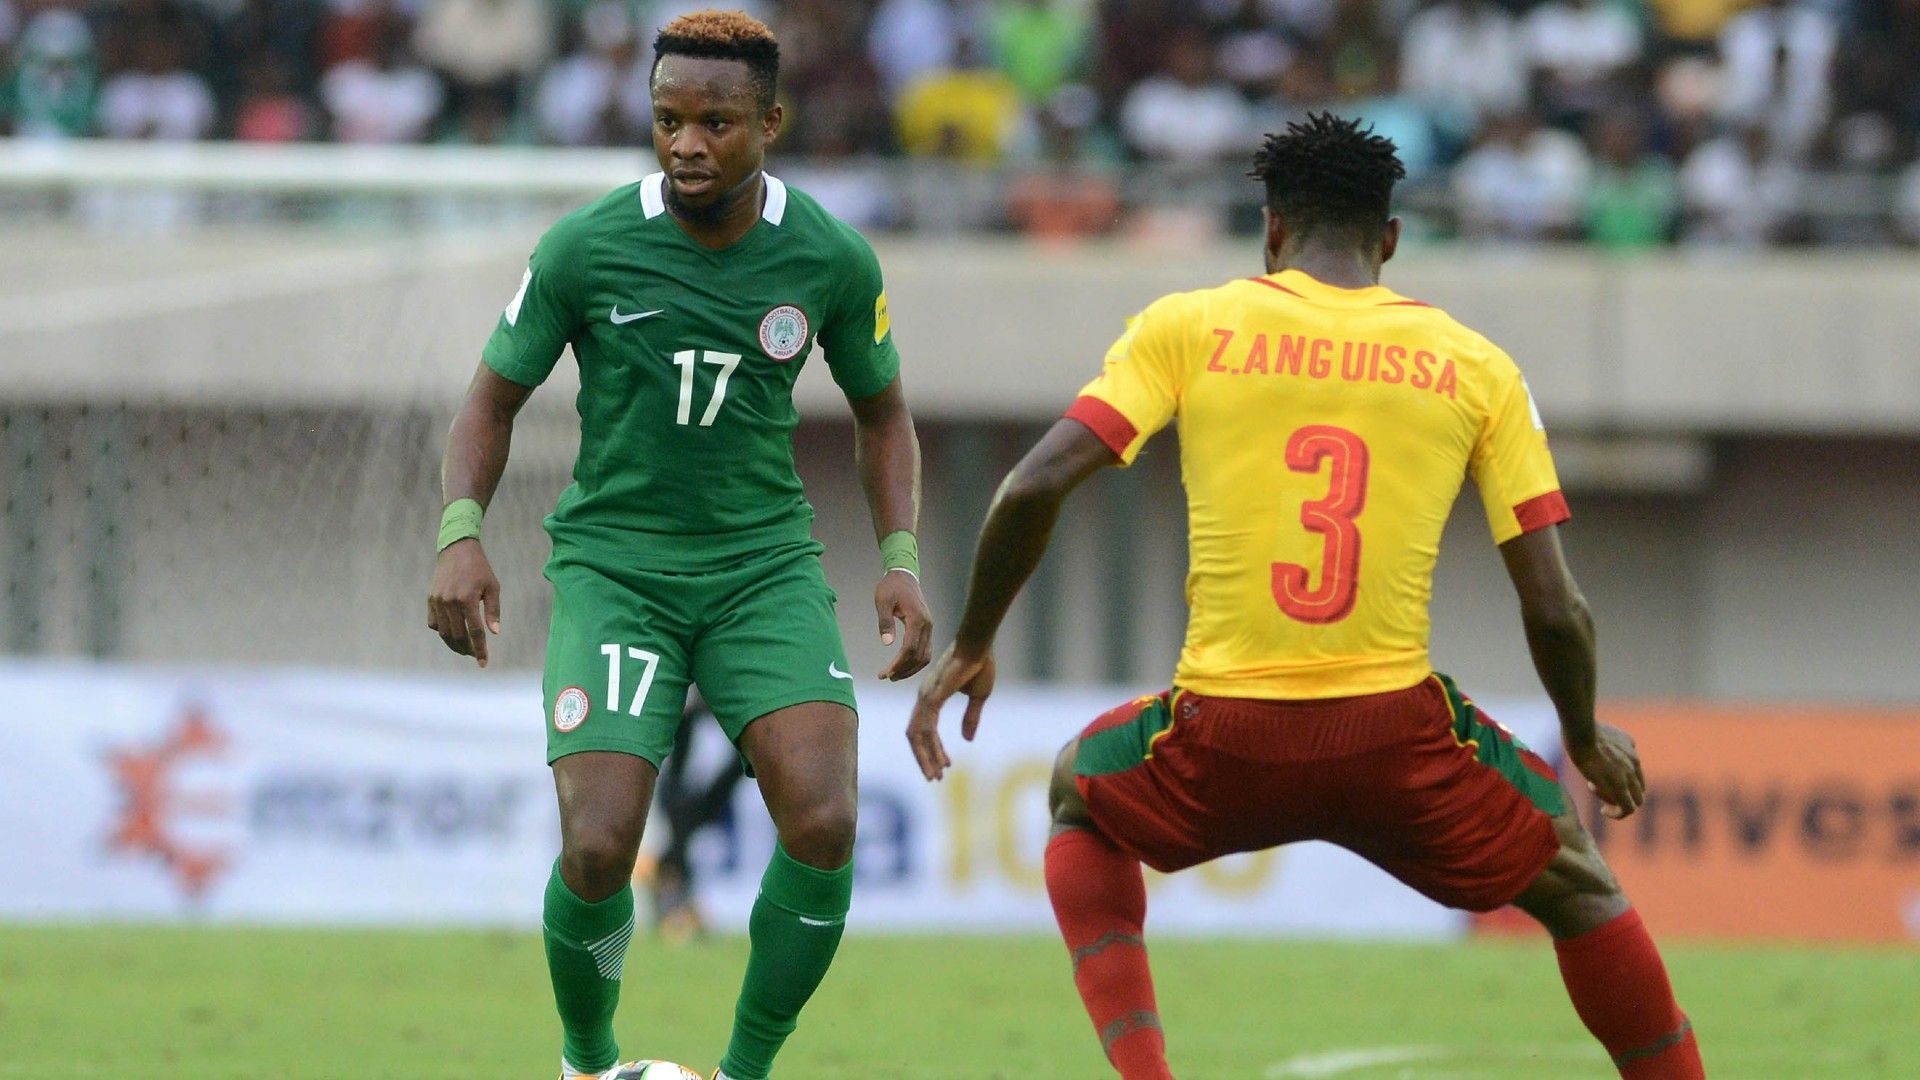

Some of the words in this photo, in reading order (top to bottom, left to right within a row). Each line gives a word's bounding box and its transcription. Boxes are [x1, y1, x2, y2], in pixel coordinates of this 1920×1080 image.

[766, 308, 795, 324] FOOTBALL
[673, 350, 742, 426] 17
[1206, 328, 1458, 401] Z.ANGUISSA
[1270, 424, 1371, 626] 3
[600, 643, 660, 717] 17
